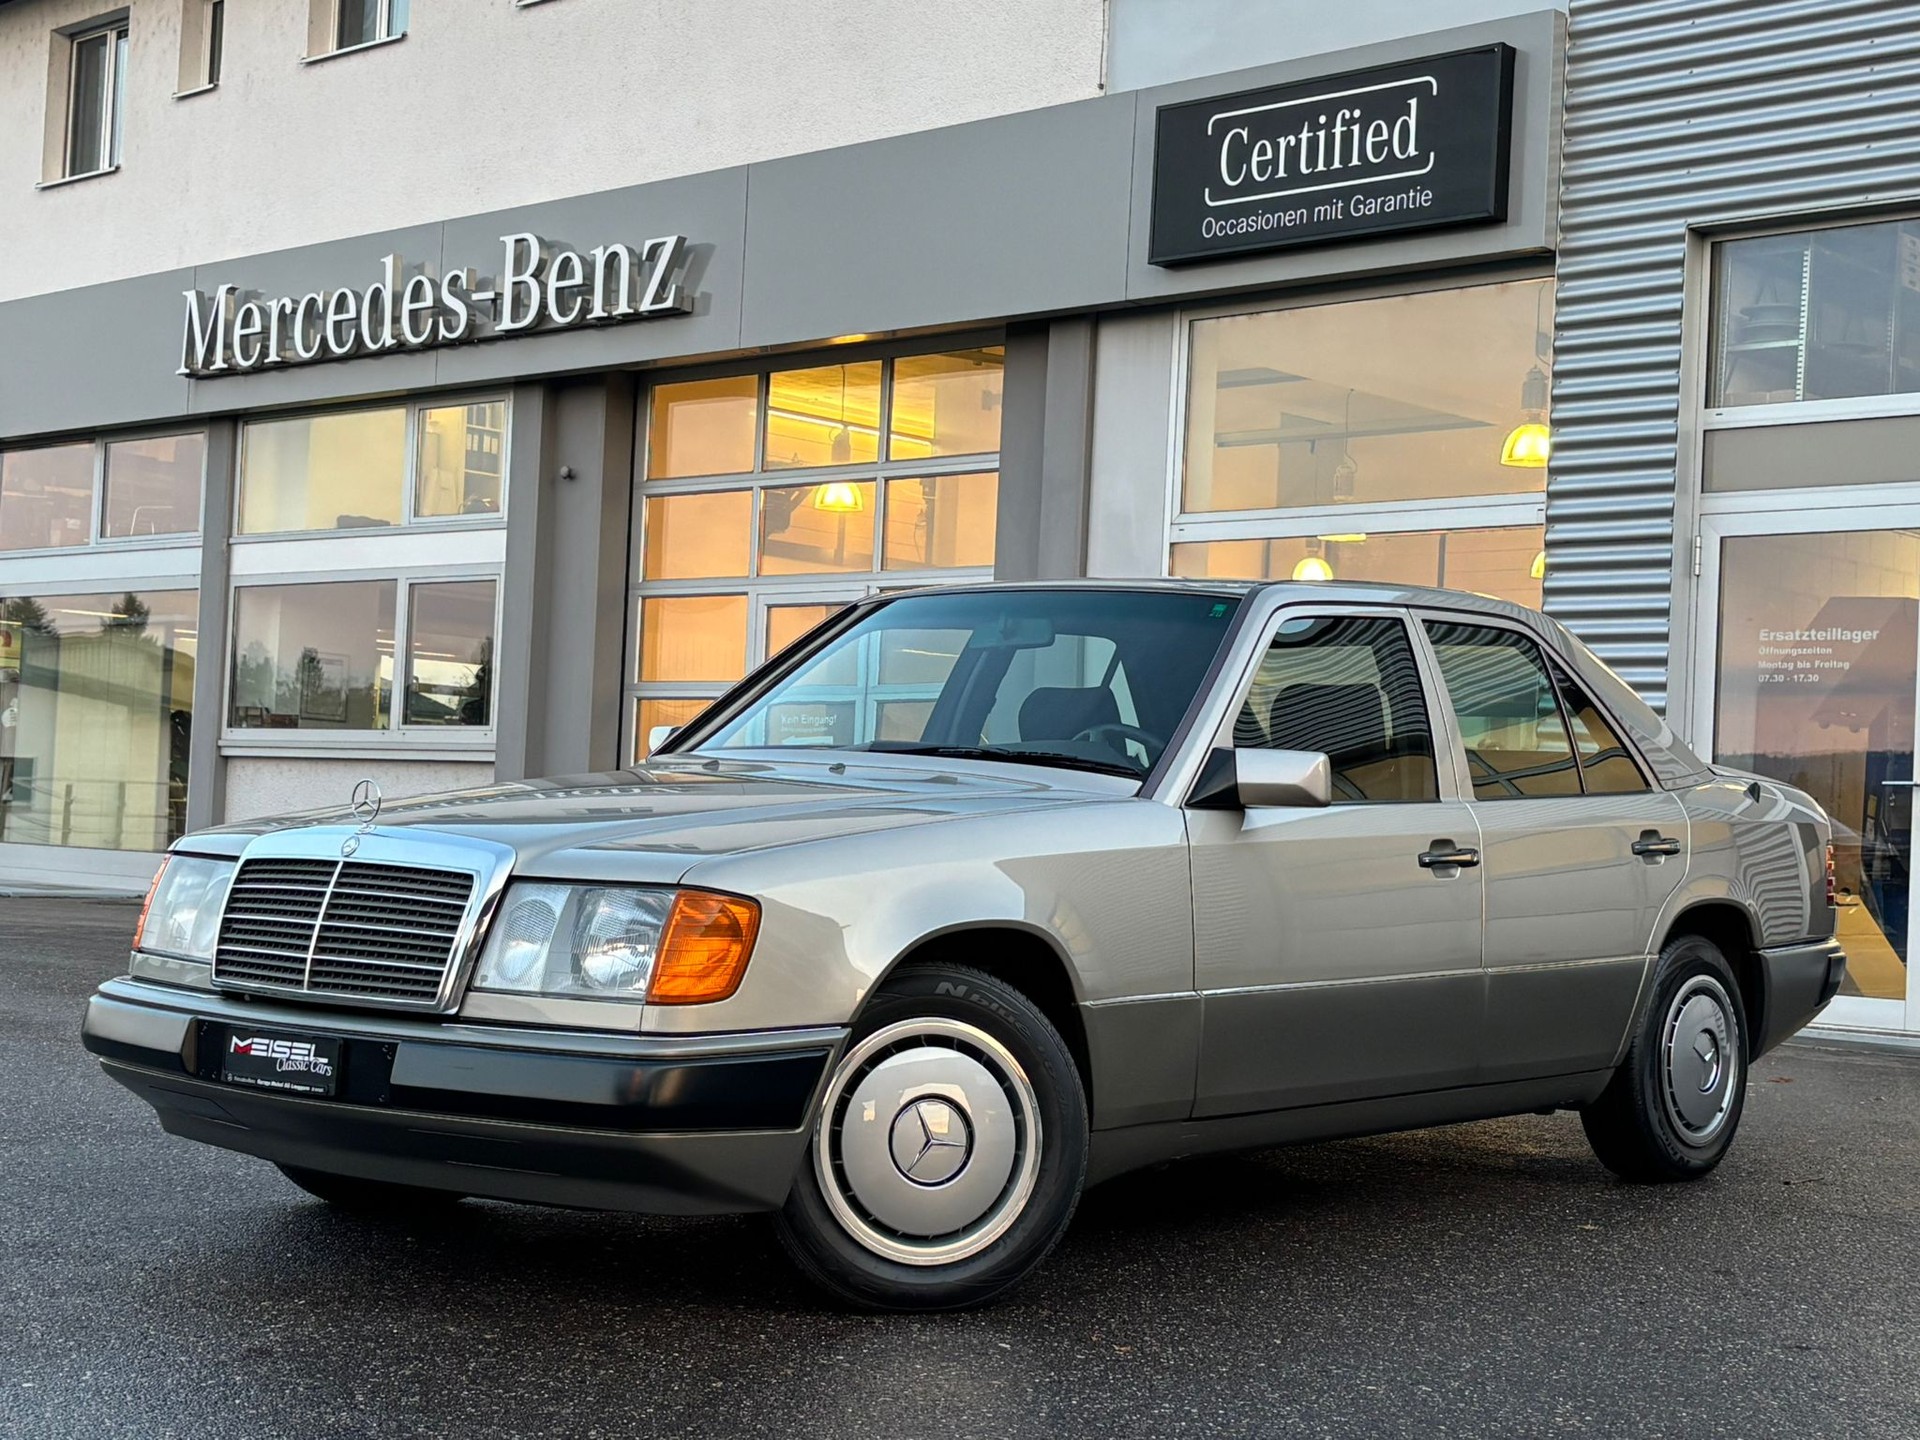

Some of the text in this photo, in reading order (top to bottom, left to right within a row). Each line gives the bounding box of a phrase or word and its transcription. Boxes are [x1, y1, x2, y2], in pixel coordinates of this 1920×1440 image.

[1219, 97, 1419, 187] Certified
[1201, 186, 1433, 239] Occasionen mit Garantie
[175, 231, 692, 377] Mercedes-Benz
[1759, 627, 1880, 643] Ersatzteillager
[1758, 646, 1833, 656] Öffnungszeiten
[1757, 659, 1850, 671] Montag bis Freitag
[230, 1035, 329, 1064] MEISEL
[276, 1057, 333, 1077] Classic Cars
